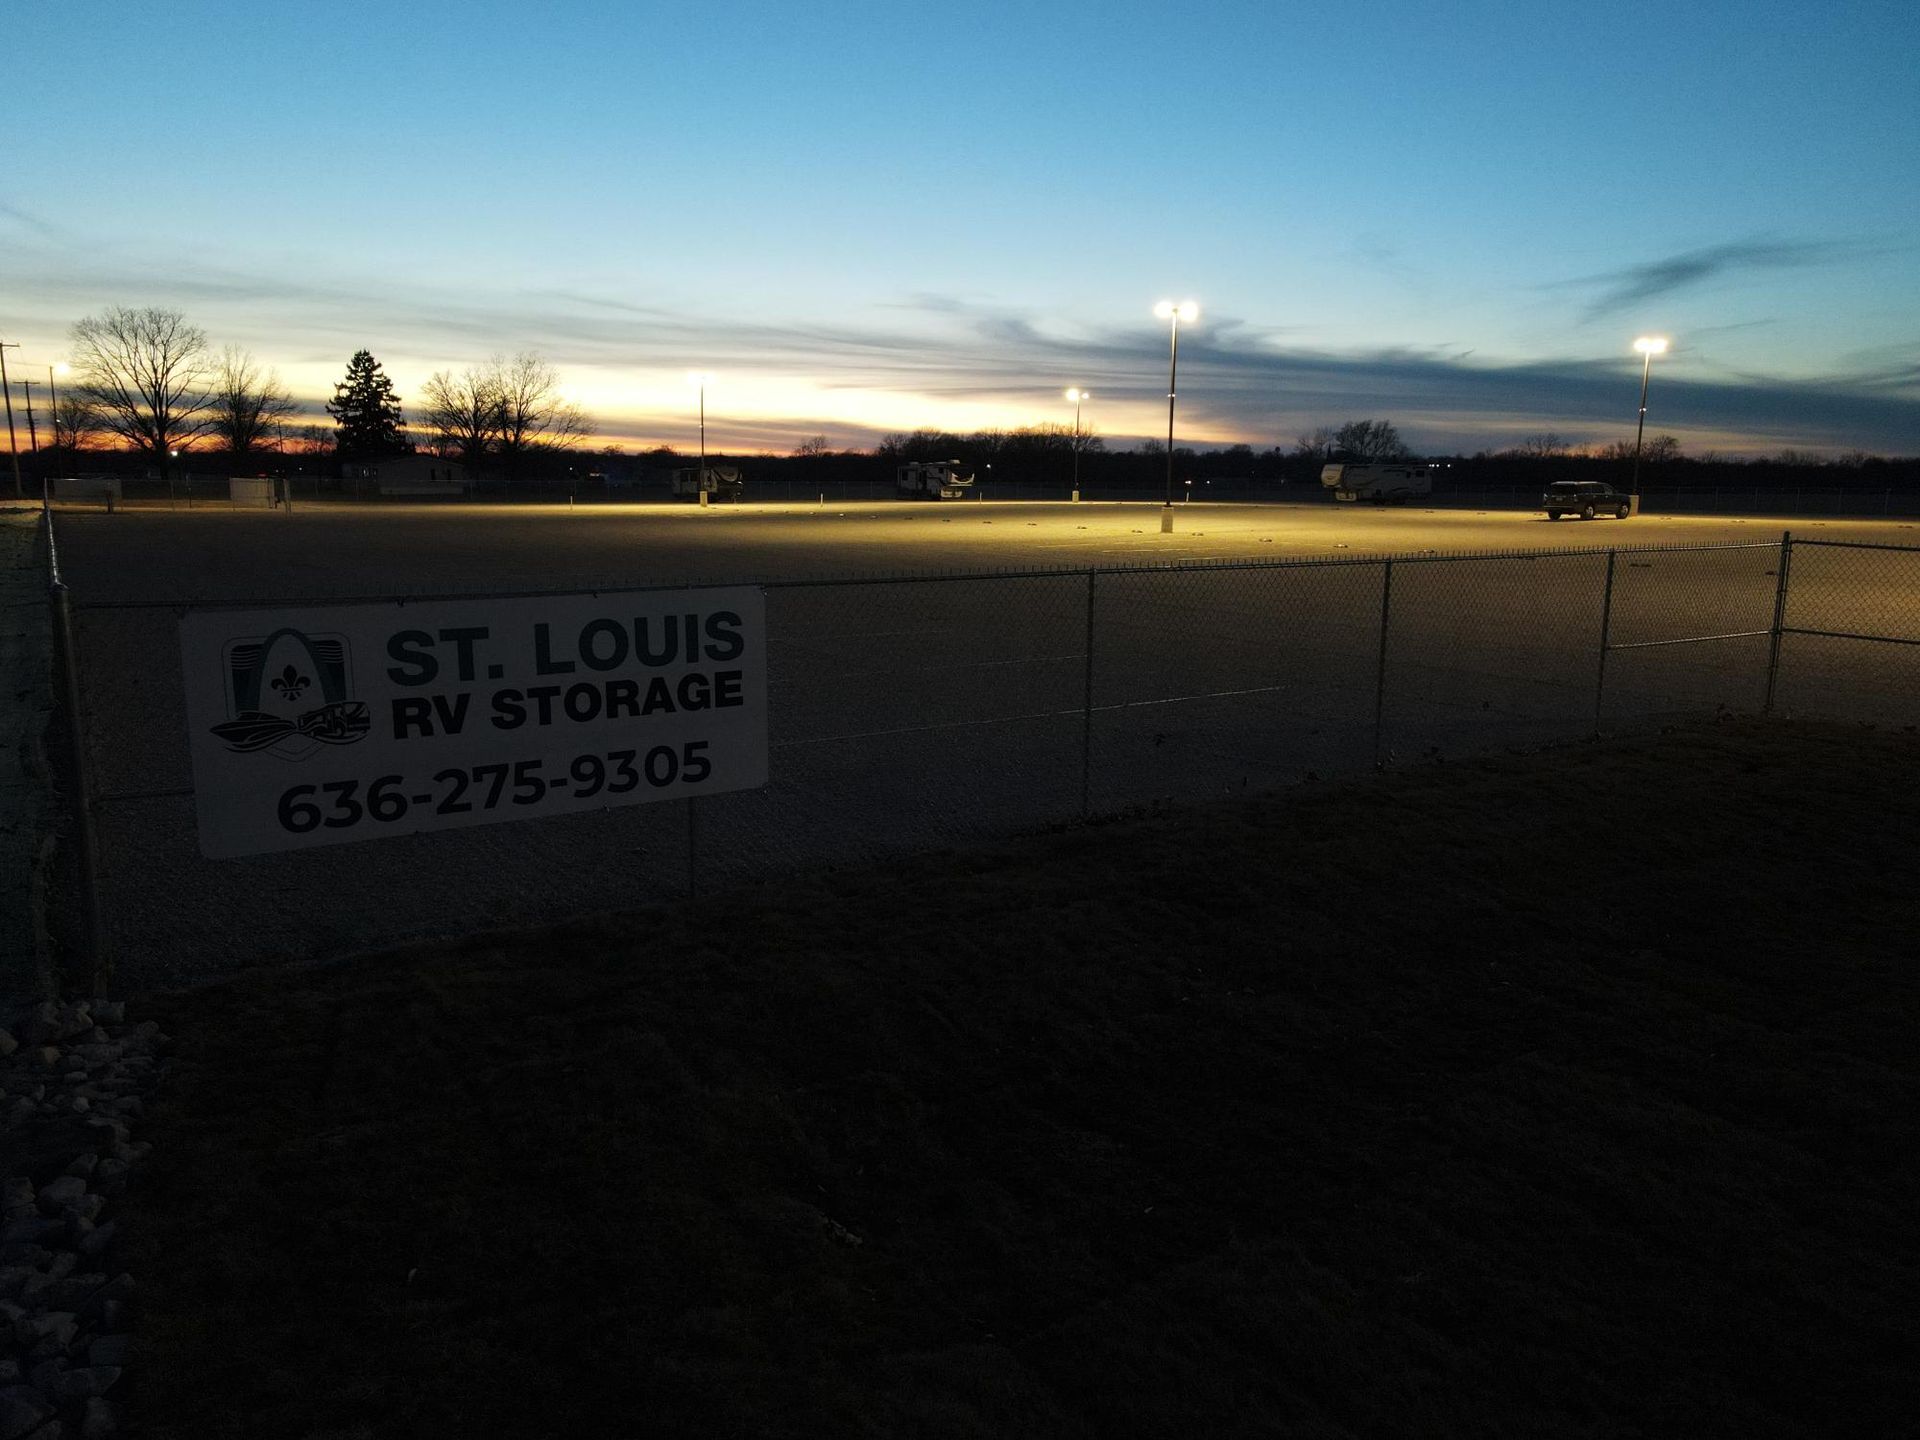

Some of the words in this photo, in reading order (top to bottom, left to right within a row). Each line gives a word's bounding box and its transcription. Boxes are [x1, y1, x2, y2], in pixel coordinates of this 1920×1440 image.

[386, 626, 504, 687] ST.
[534, 610, 745, 676] LOUIS
[391, 693, 471, 740] RV
[490, 670, 744, 730] STORAGE
[277, 741, 712, 834] 636-275-9305
